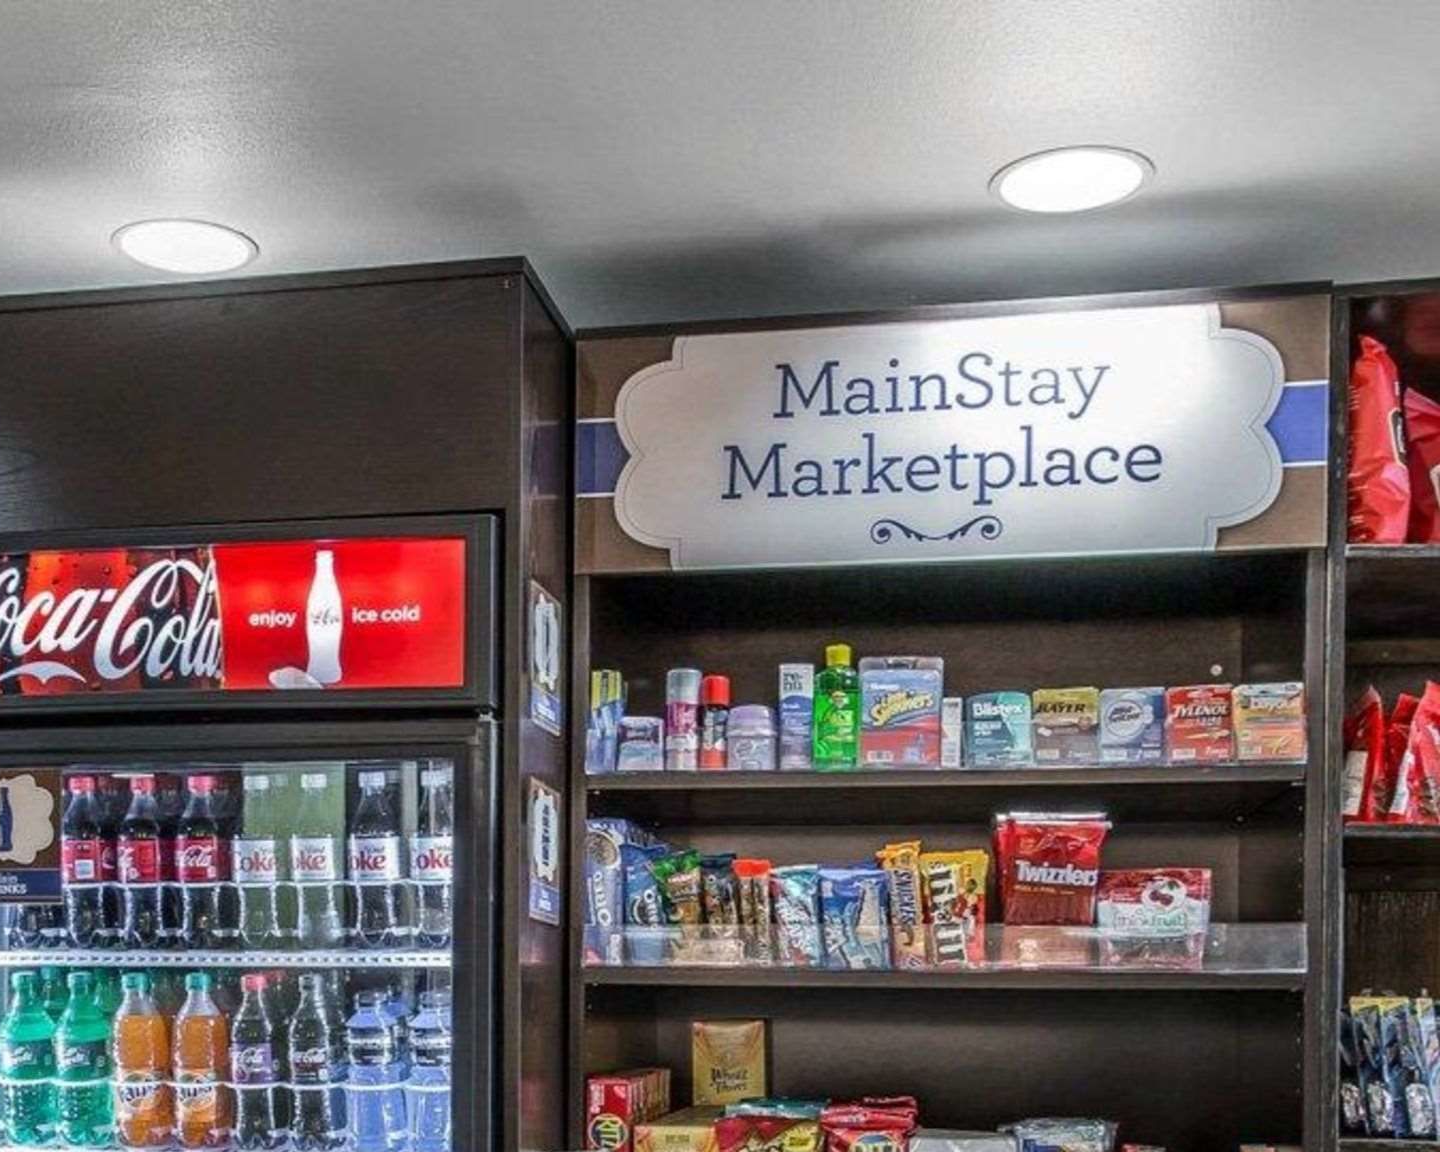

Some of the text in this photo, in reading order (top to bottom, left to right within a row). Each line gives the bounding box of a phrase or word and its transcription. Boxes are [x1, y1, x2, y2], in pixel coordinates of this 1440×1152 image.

[771, 352, 1111, 418] MainStay
[720, 425, 1164, 505] Marketplace
[249, 609, 296, 628] enjoy
[351, 606, 378, 623] ice
[380, 604, 421, 623] cold
[973, 702, 1024, 717] Blistex
[1038, 703, 1086, 713] BAYER
[1173, 704, 1229, 719] TYLENOL
[240, 850, 277, 873] oke
[351, 849, 387, 871] oke
[416, 848, 452, 871] oke
